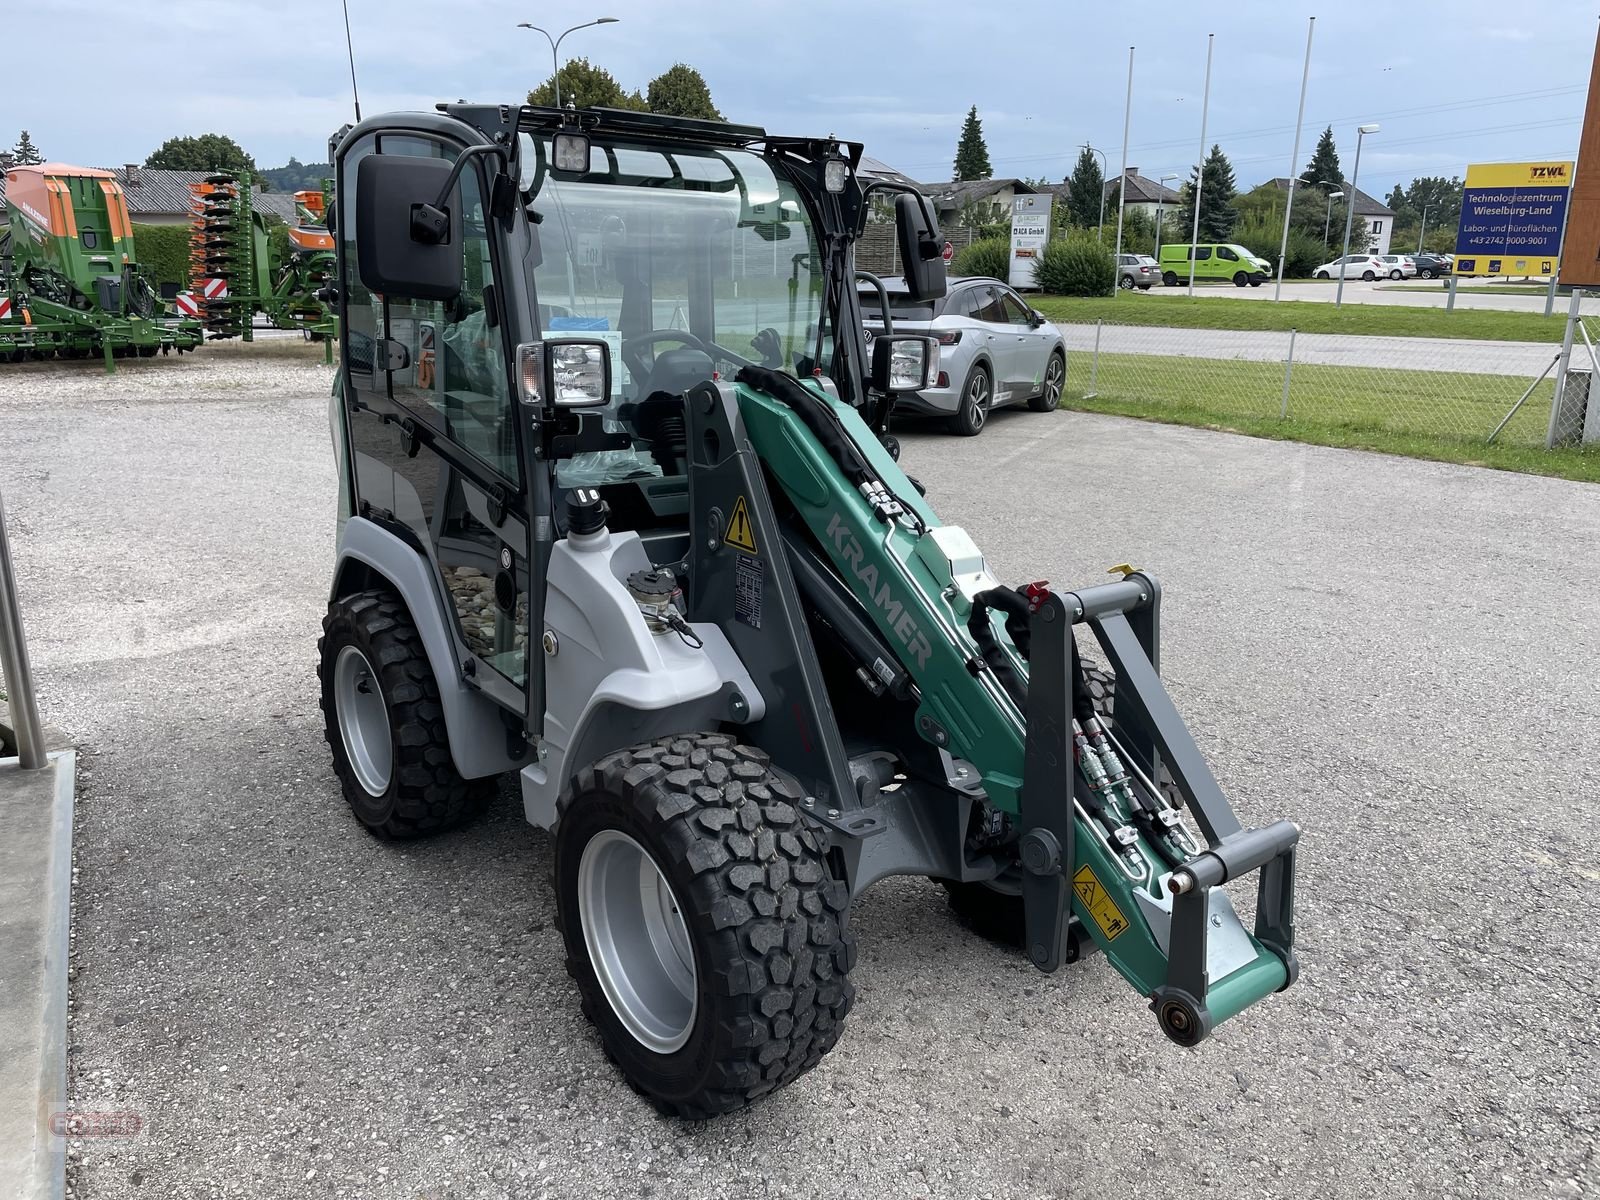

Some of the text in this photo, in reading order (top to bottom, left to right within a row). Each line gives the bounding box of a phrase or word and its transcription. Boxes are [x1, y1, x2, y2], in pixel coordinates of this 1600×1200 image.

[1531, 166, 1565, 179] TZWL
[1468, 193, 1562, 204] Technologiezentrum
[1473, 206, 1553, 217] Wieselburg-Land
[1463, 223, 1558, 233] Labor- und Büroflächen
[1485, 237, 1504, 245] 2742
[1506, 236, 1548, 245] 9000-9001
[826, 512, 932, 672] KRAMER
